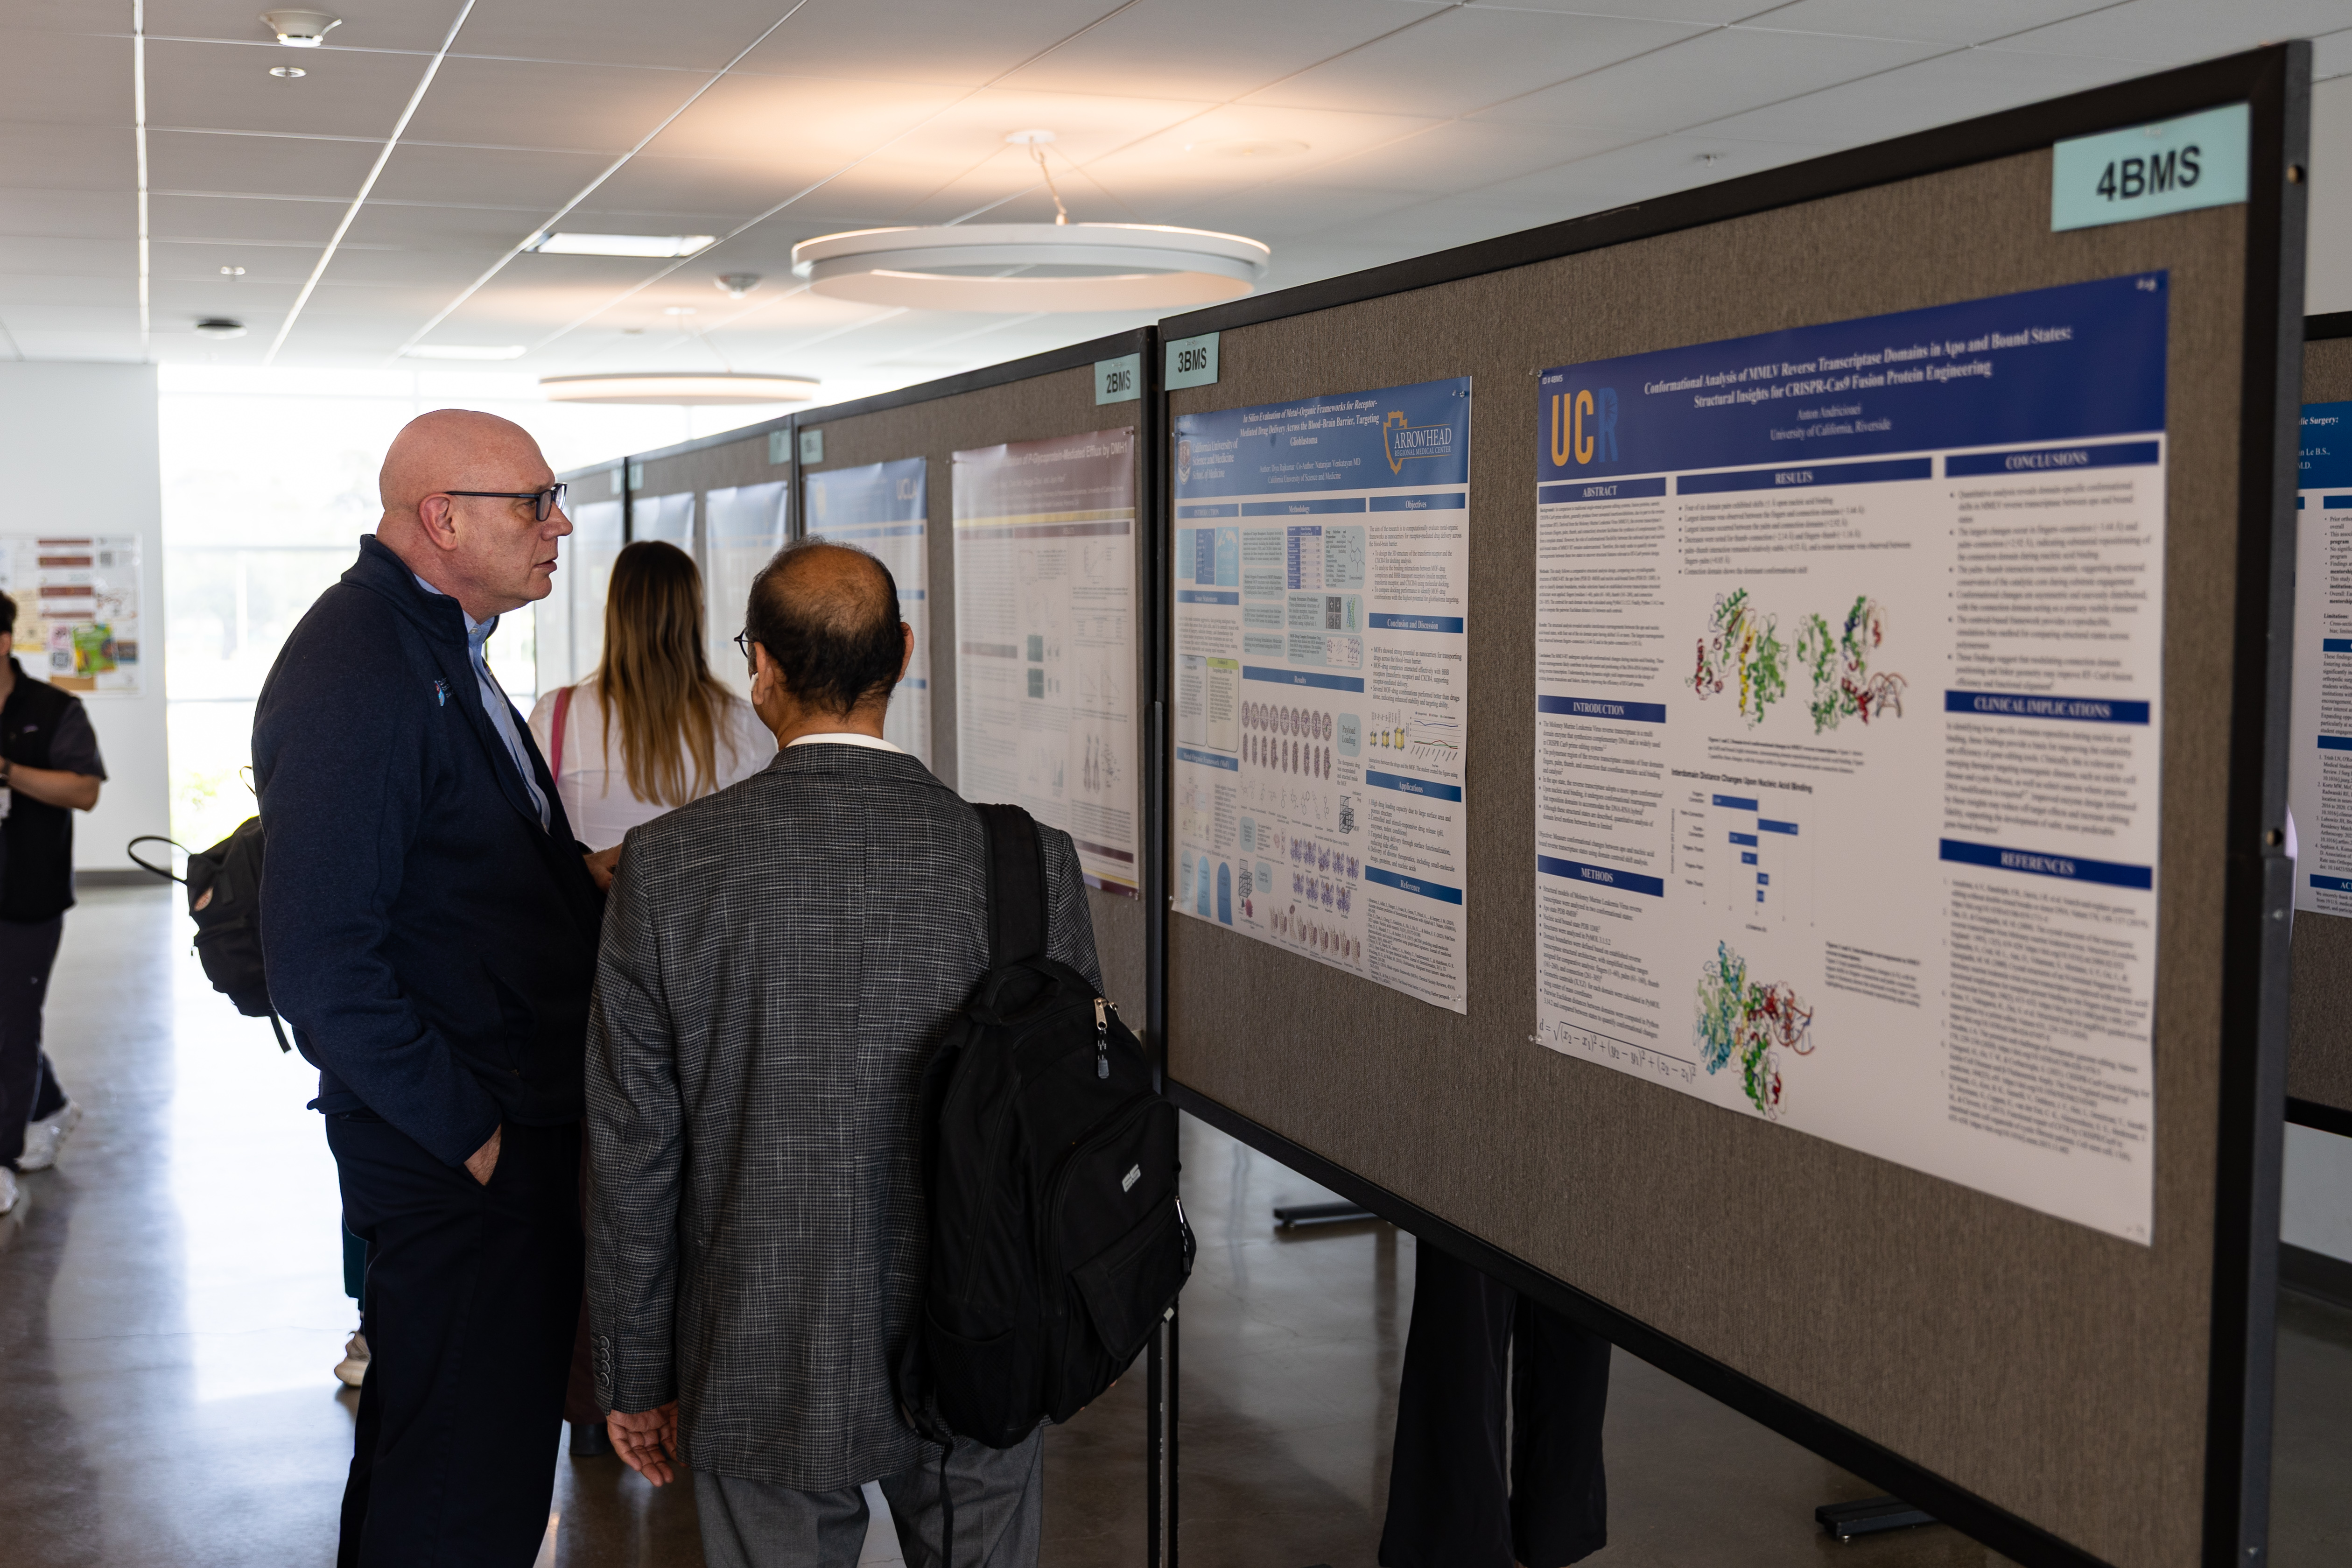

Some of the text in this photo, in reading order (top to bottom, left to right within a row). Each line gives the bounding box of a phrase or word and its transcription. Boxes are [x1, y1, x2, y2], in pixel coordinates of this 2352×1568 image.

[2096, 145, 2200, 202] 4BMS
[1178, 347, 1207, 373] 3BMS
[1644, 375, 1702, 395] Conformational
[1704, 371, 1737, 388] Analysis
[1738, 368, 1748, 382] of
[1781, 362, 1816, 376] Reverse
[1818, 352, 1882, 371] Transcriptase
[1884, 345, 1929, 363] Domains
[1930, 340, 1940, 356] in
[1943, 341, 1965, 358] Apo
[1967, 335, 1989, 352] and
[1991, 330, 2029, 349] Bound
[2031, 326, 2073, 344] States:
[1106, 369, 1130, 394] 2BMS
[1694, 359, 1992, 408] Structural Insights for CRISPR-Cas9 Fusion Protein Engineering
[1259, 411, 1281, 422] Evaluation
[1281, 409, 1287, 418] of
[1317, 401, 1346, 414] Frameworks
[1354, 399, 1377, 411] Receptor-
[1240, 426, 1257, 437] Mediated
[1258, 425, 1268, 437] Drug
[1269, 423, 1285, 435] Delivery
[1286, 422, 1300, 433] Across
[1336, 416, 1355, 427] Barrier,
[1356, 413, 1379, 427] Targeting
[1552, 387, 1618, 466] UCR
[2310, 416, 2338, 426] Surgery:
[1770, 427, 1805, 441] University
[1806, 426, 1815, 437] of
[1855, 417, 1891, 433] Riverside
[1212, 439, 1233, 452] University
[1290, 436, 1318, 446] Glioblastoma
[1394, 428, 1452, 449] ARROWHEAD
[1103, 444, 1109, 458] by
[1394, 445, 1452, 457] REGIONAL MEDICAL CENTER
[2005, 450, 2089, 470] CONCLUSIONS
[1284, 474, 1300, 484] University
[1305, 472, 1318, 481] Science
[1325, 471, 1341, 480] Medicine
[1775, 471, 1814, 485] RESULTS
[1582, 485, 1618, 498] ABSTRACT
[1289, 505, 1310, 513] Methodology
[1405, 499, 1427, 510] Objectives
[1387, 618, 1409, 629] Conclusion
[1418, 619, 1438, 630] Discussion
[1294, 675, 1307, 684] Results
[1573, 702, 1624, 716] INTRODUCTION
[1973, 695, 2112, 718] CLINICAL IMPLICATIONS
[1342, 725, 1355, 735] Payload
[1342, 735, 1356, 746] Loading
[1398, 780, 1423, 793] Applications
[1700, 771, 1720, 781] Distance
[1722, 774, 1742, 785] Changes
[1744, 777, 1756, 786] Upon
[1790, 781, 1813, 794] Binding
[2000, 851, 2076, 875] REFERENCES
[1580, 867, 1614, 883] METHODS
[1400, 879, 1420, 893] Reference
[2340, 882, 2352, 890] AC
